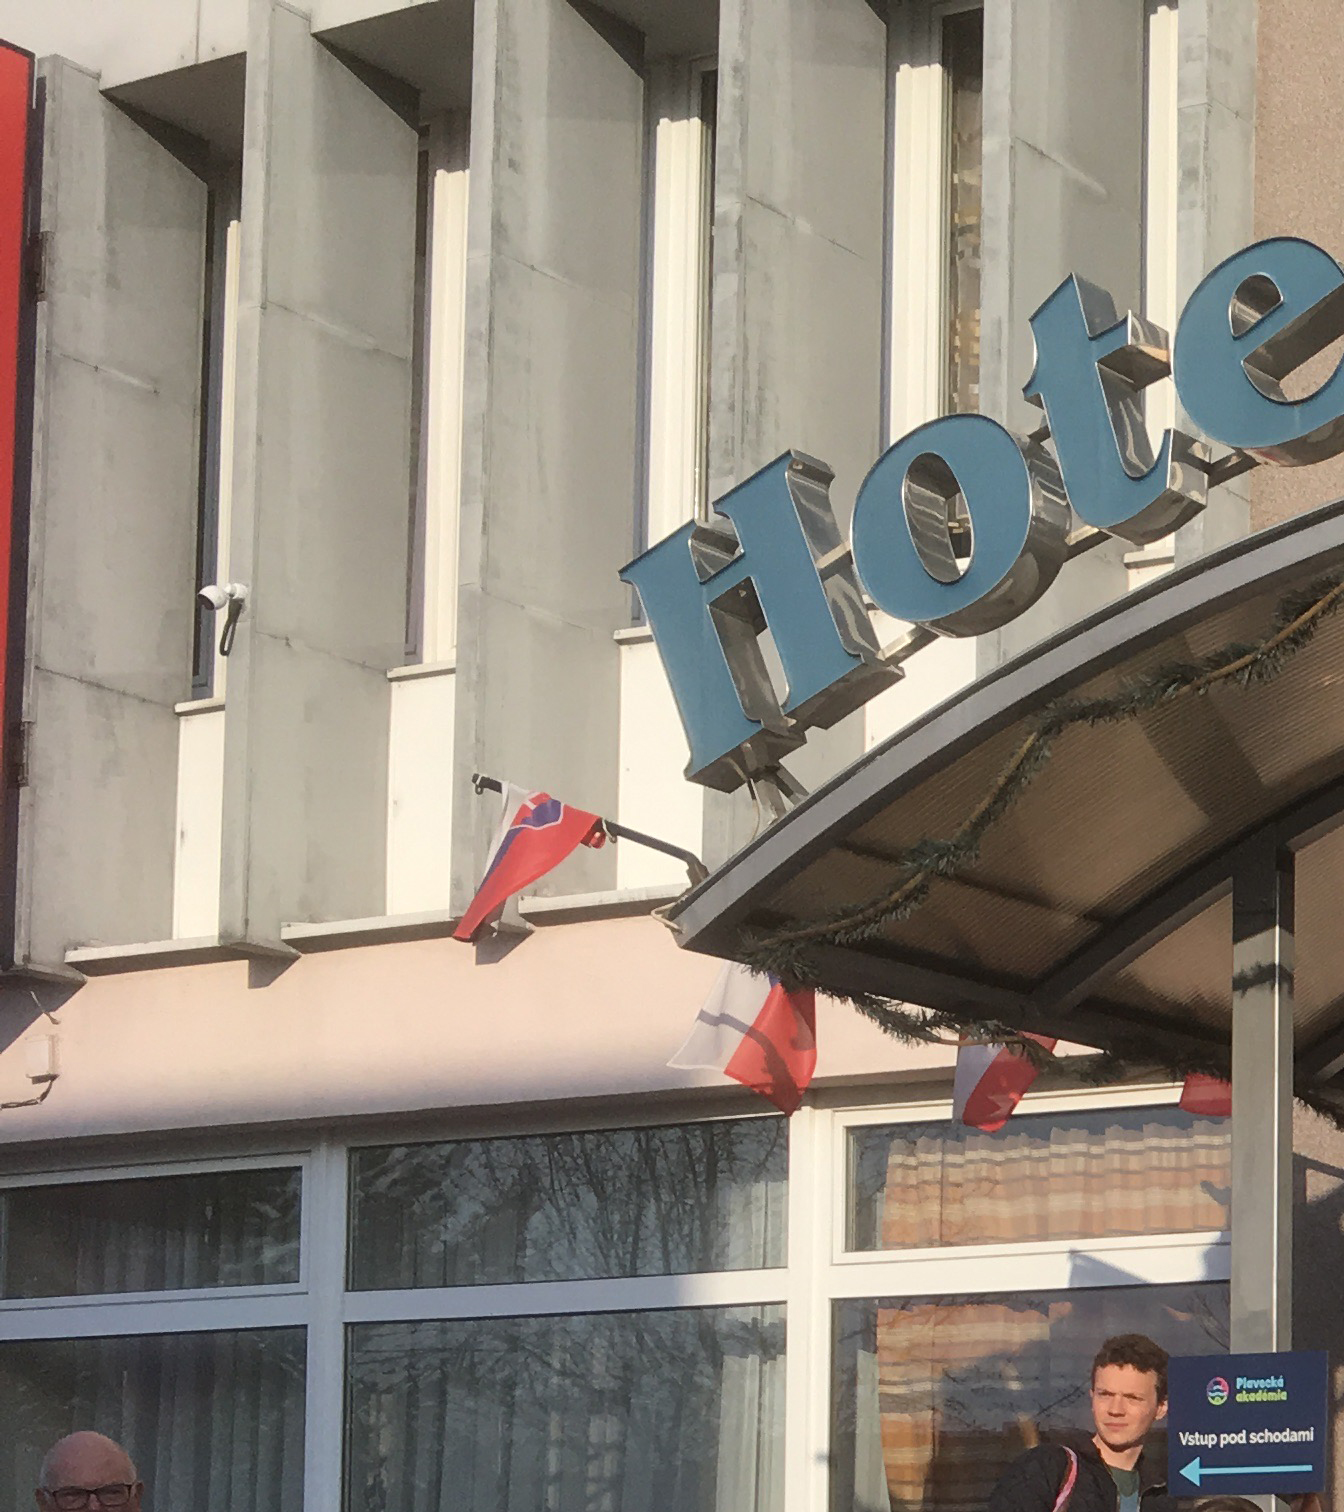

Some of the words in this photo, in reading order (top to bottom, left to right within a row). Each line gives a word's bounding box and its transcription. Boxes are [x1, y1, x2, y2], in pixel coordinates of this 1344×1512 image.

[1236, 1375, 1284, 1389] Plavecká
[1235, 1389, 1288, 1402] akadémia
[1179, 1431, 1217, 1448] Vstup
[1220, 1430, 1246, 1448] pod
[1249, 1427, 1314, 1444] schodami
